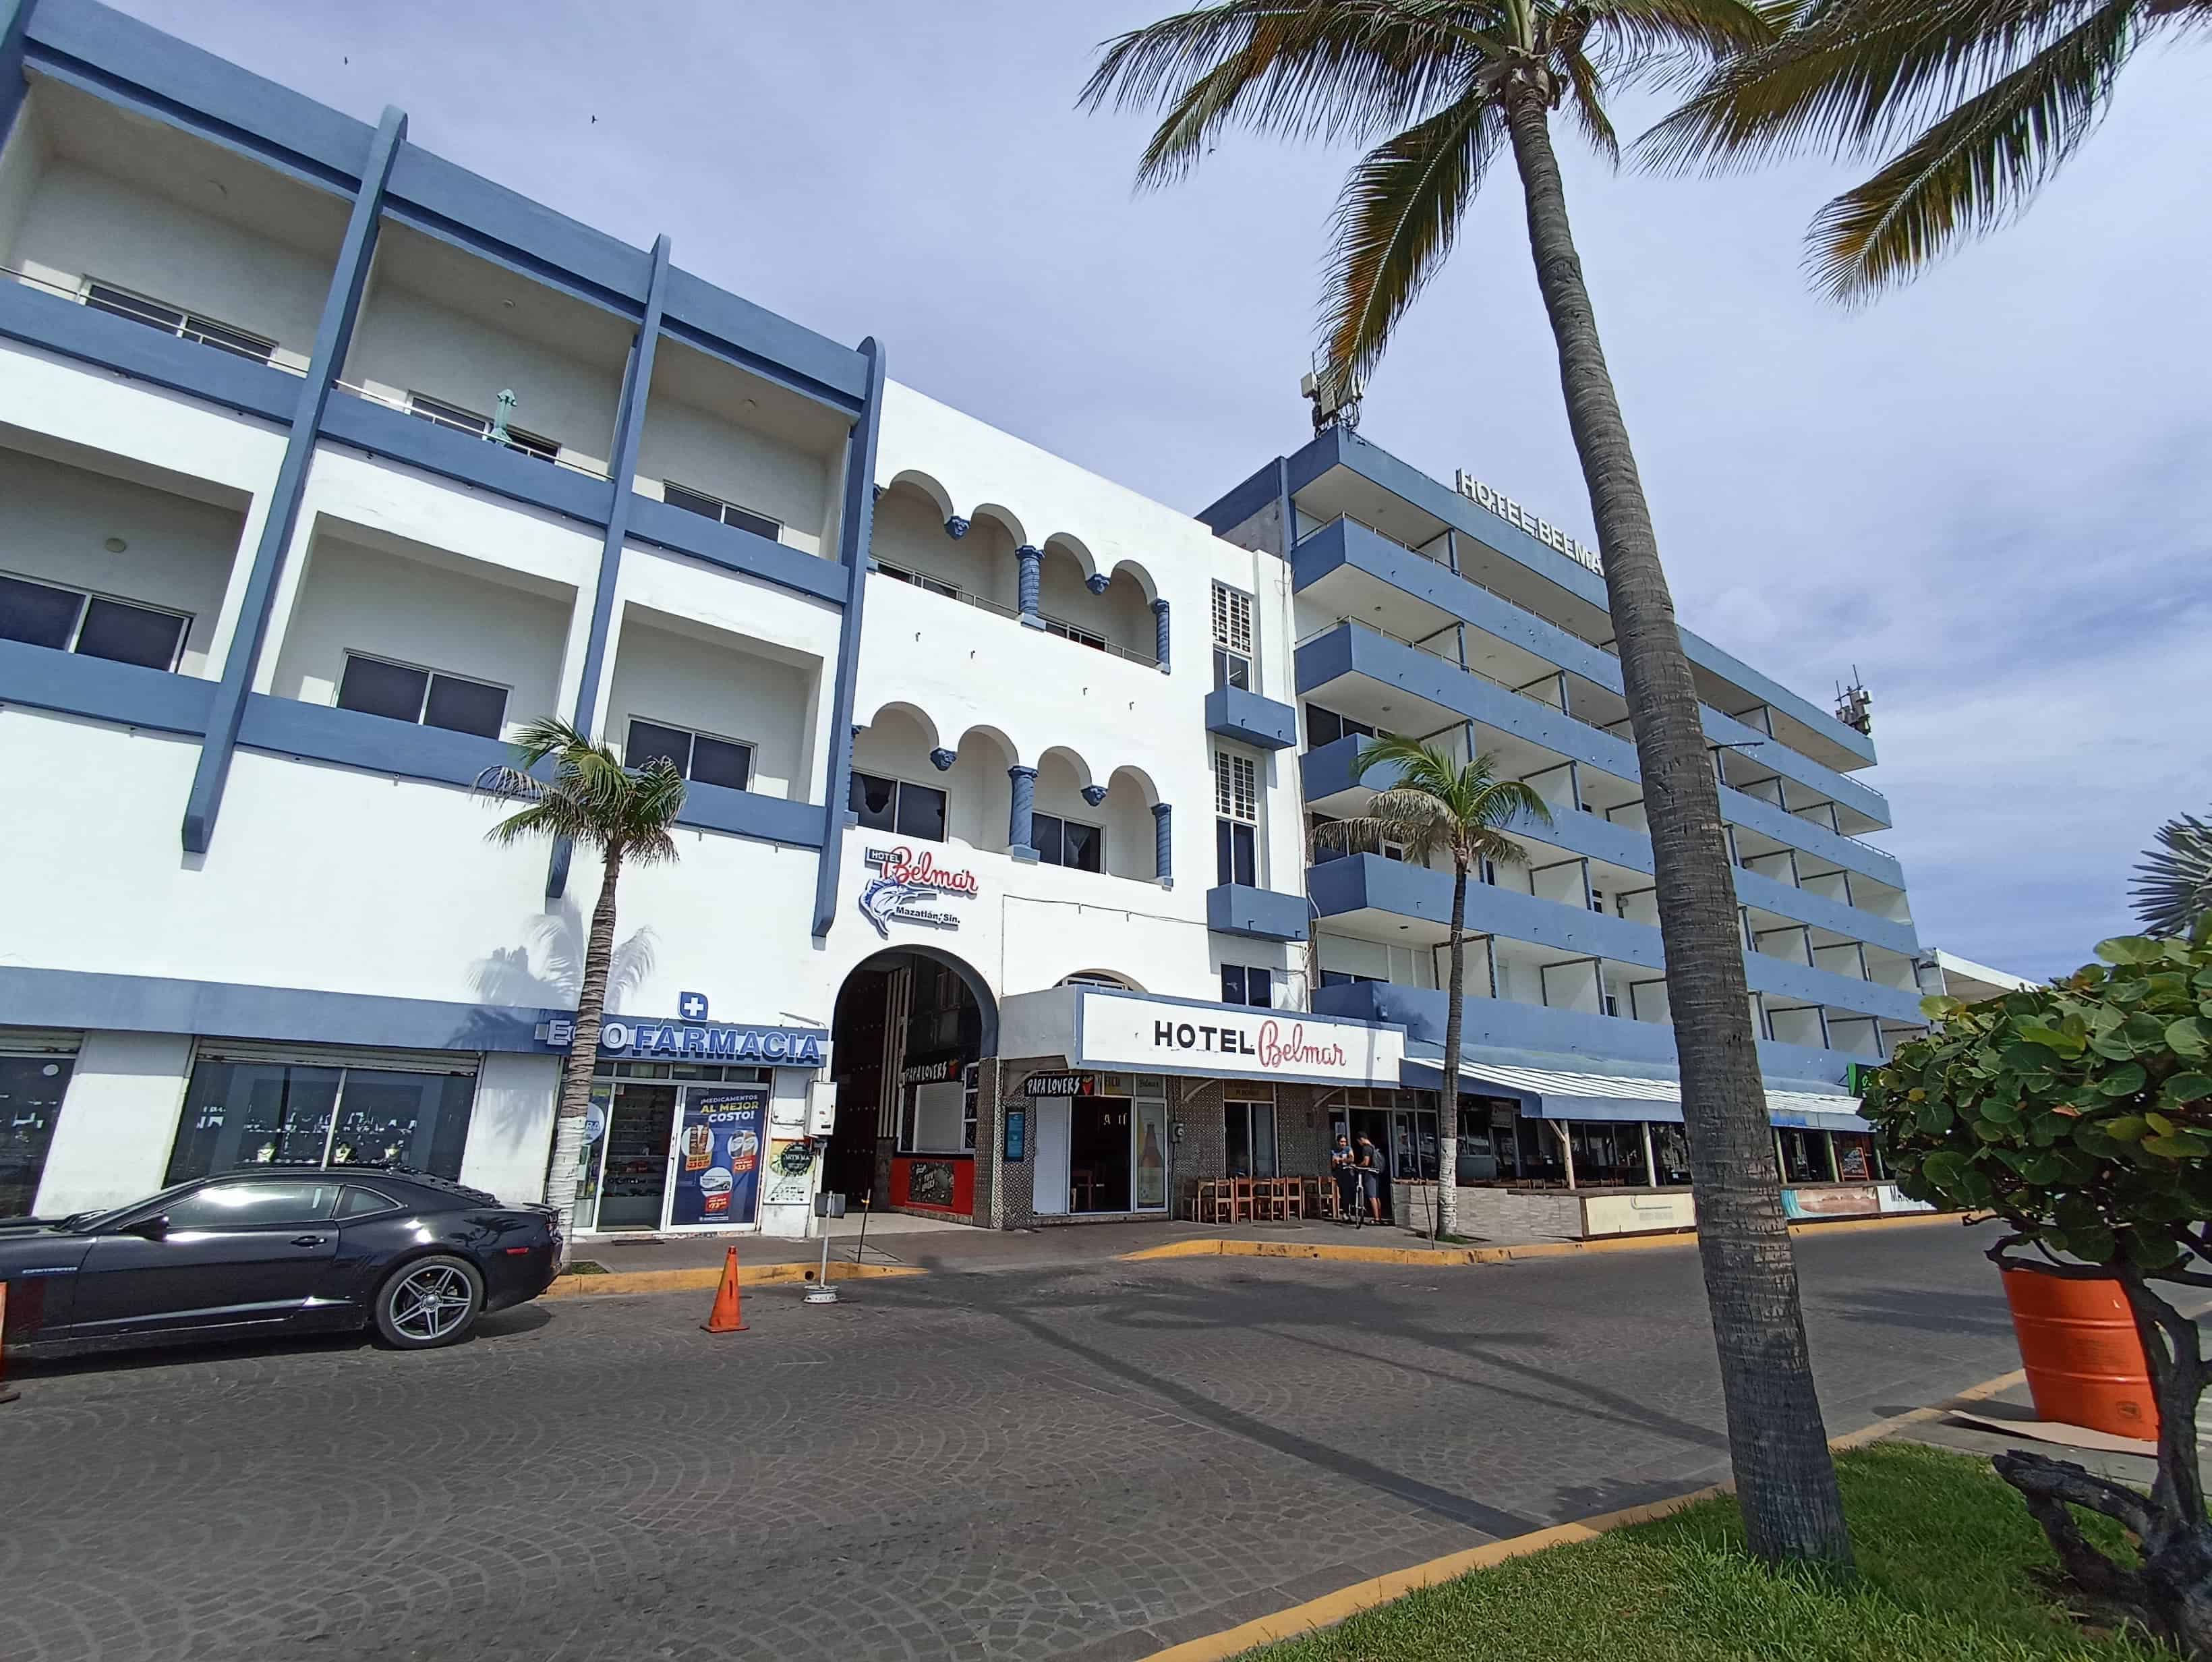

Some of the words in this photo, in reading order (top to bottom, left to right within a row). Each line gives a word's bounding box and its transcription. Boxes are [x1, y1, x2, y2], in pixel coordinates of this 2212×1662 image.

[1456, 468, 1537, 537] HOTEL
[1537, 517, 1605, 577] BELMA
[872, 851, 900, 863] HOTEL
[884, 847, 978, 892] Belmar
[944, 914, 960, 923] Sin.
[1155, 1021, 1256, 1055] HOTEL
[1258, 1020, 1346, 1068] Belmar
[922, 1061, 947, 1080] LOVERS
[1027, 1077, 1046, 1095] PAPA
[1047, 1077, 1080, 1095] LOVERS
[701, 1105, 716, 1113] AL
[720, 1101, 759, 1112] MEJOR
[708, 1111, 755, 1122] COSTO!
